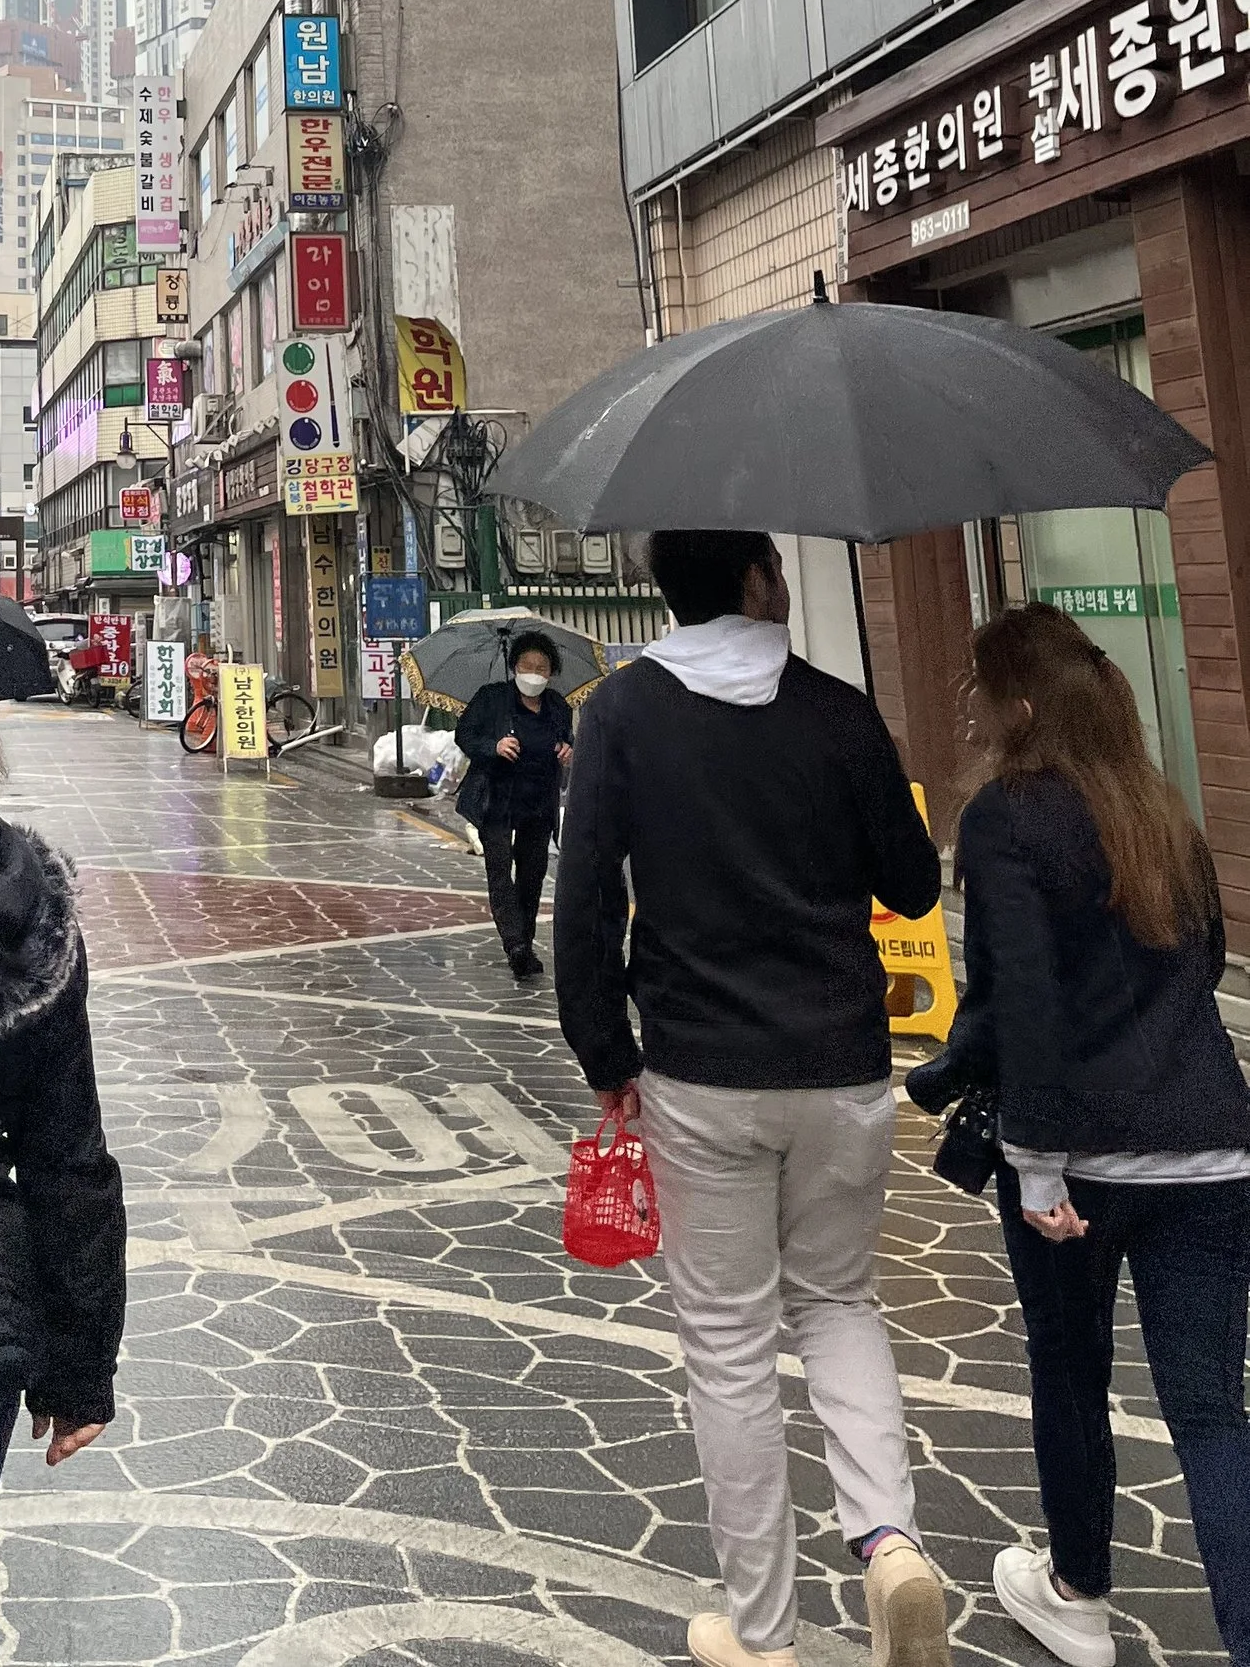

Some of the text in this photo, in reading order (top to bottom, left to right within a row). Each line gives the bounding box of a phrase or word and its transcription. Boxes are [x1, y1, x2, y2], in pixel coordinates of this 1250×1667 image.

[296, 20, 330, 85] 원남
[293, 89, 335, 105] 한의원
[845, 86, 1003, 212] 세종한의원
[1028, 53, 1061, 164] 부설
[139, 87, 154, 212] 수제숯불갈비
[300, 119, 333, 190] 한우전문
[912, 206, 970, 243] 963-0111
[409, 318, 454, 410] 학원
[303, 479, 353, 501] 철학관
[312, 524, 338, 670] 남수한의원
[1113, 588, 1138, 612] 부설
[234, 677, 256, 749] 남수한의원
